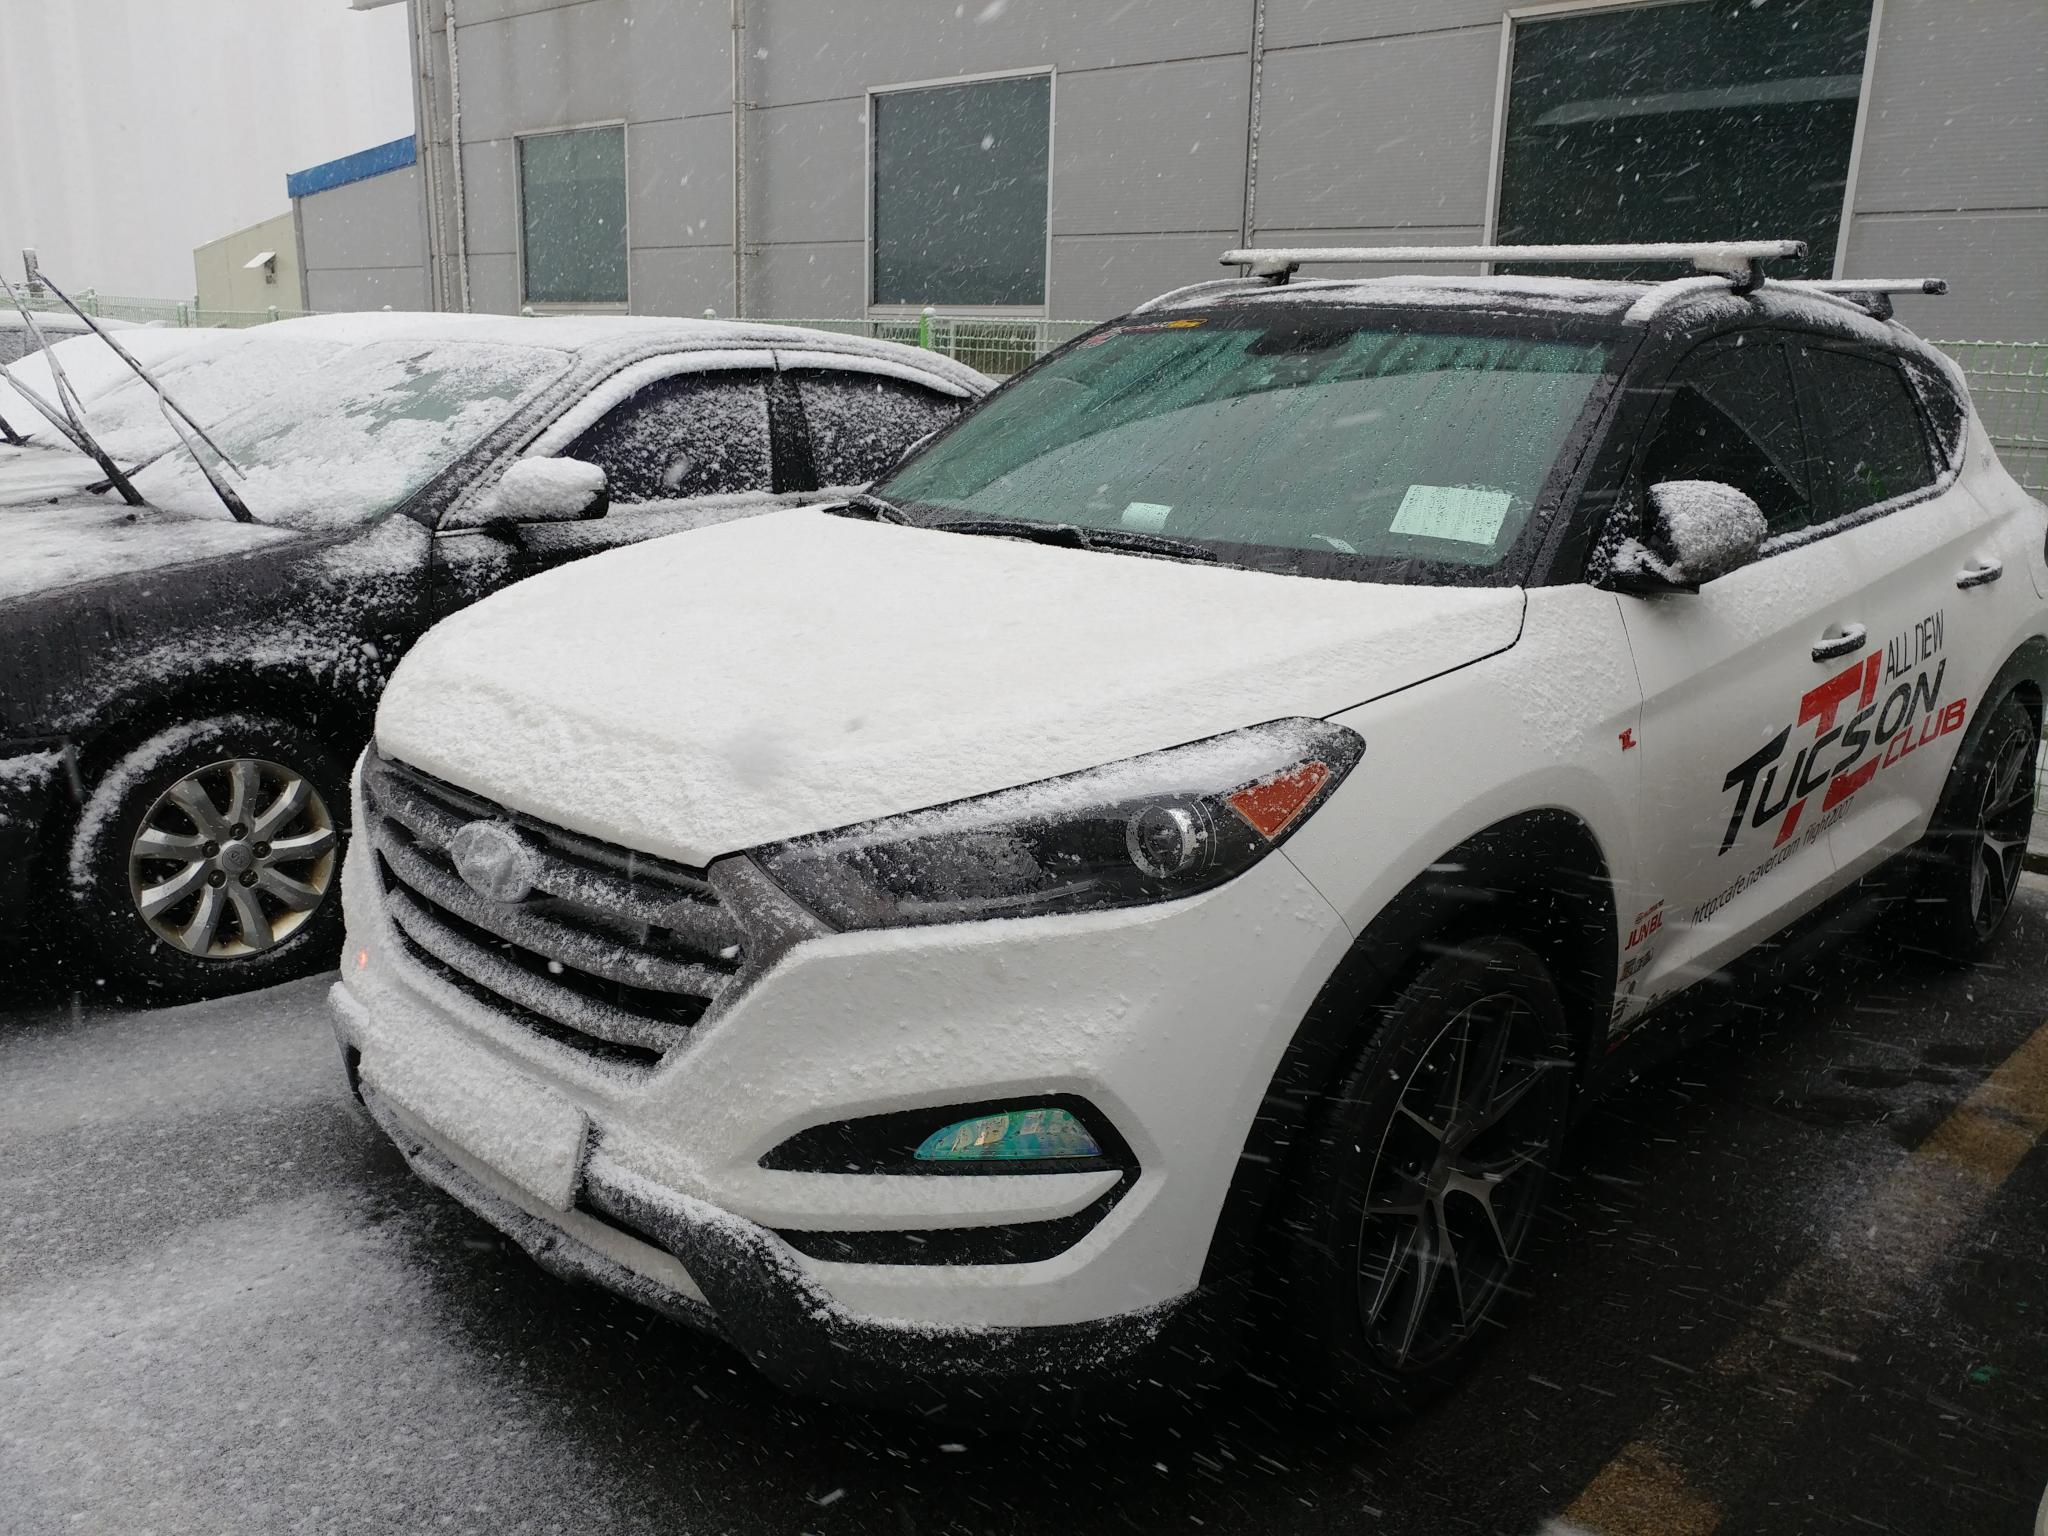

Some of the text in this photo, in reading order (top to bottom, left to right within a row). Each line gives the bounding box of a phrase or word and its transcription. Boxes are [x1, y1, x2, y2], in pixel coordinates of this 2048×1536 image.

[1885, 632, 1912, 685] ALL
[1718, 657, 1947, 856] TUCSON
[1882, 698, 1967, 769] CLUB
